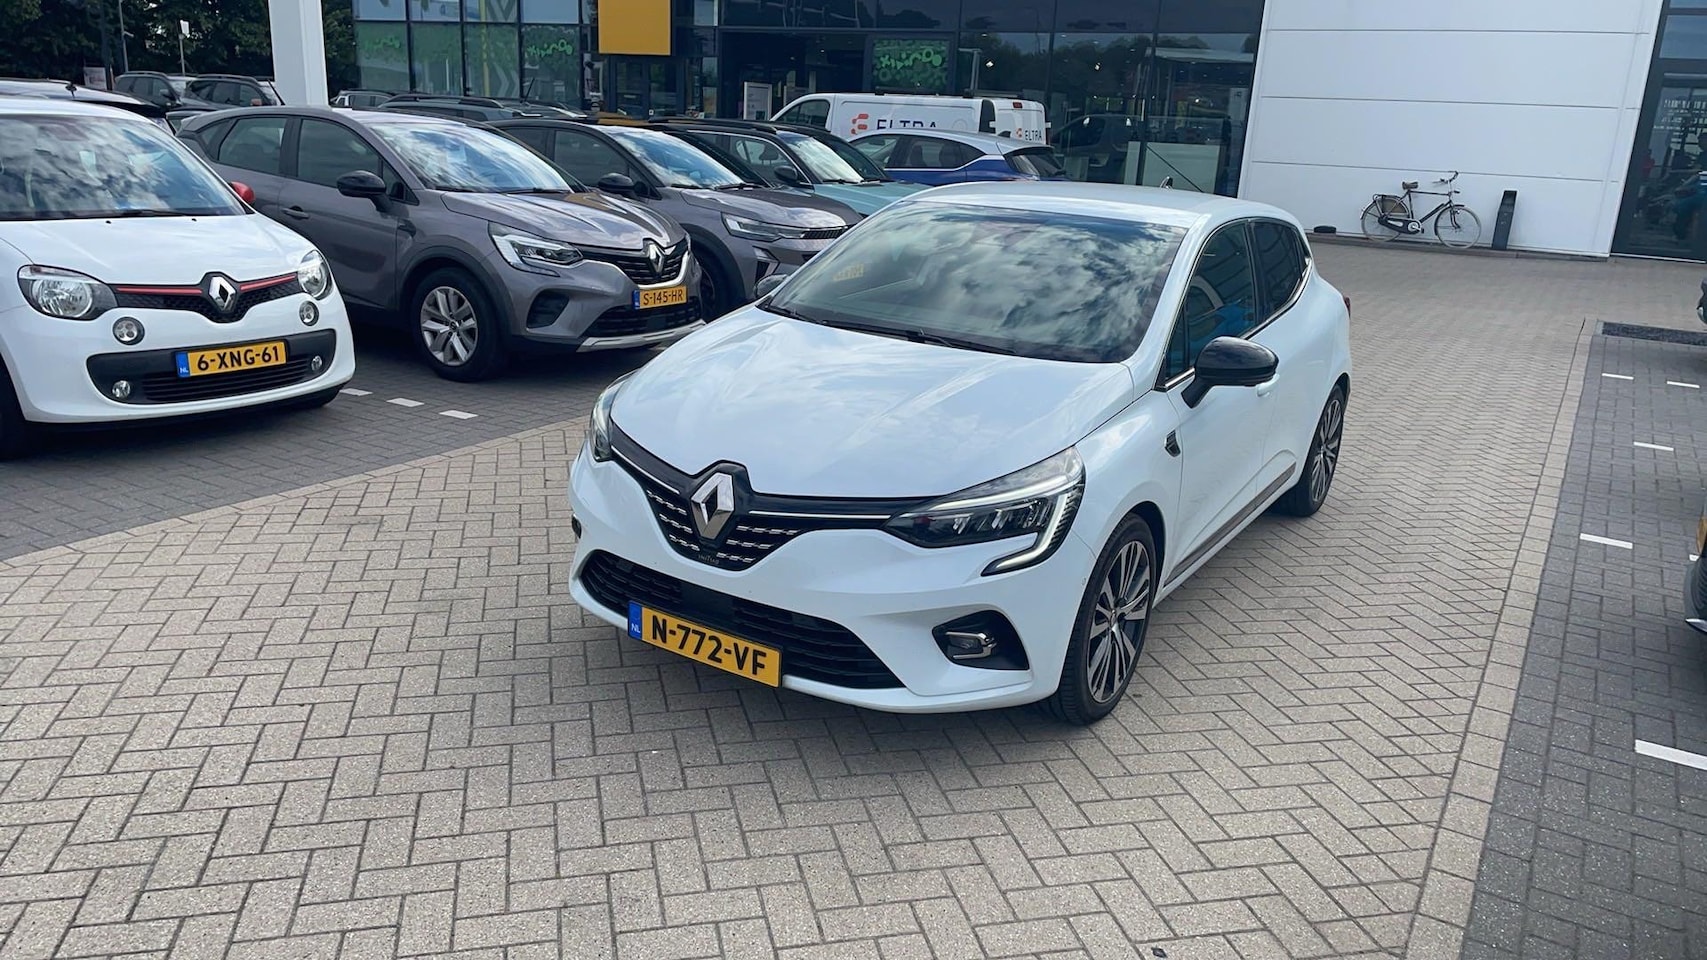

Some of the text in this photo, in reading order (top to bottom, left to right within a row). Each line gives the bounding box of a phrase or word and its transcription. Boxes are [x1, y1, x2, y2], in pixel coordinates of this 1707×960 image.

[1025, 130, 1042, 140] ELTRA
[643, 289, 683, 306] S-145-HR
[197, 346, 279, 371] 6-XNG-61
[631, 615, 767, 675] NL N-772-VF
